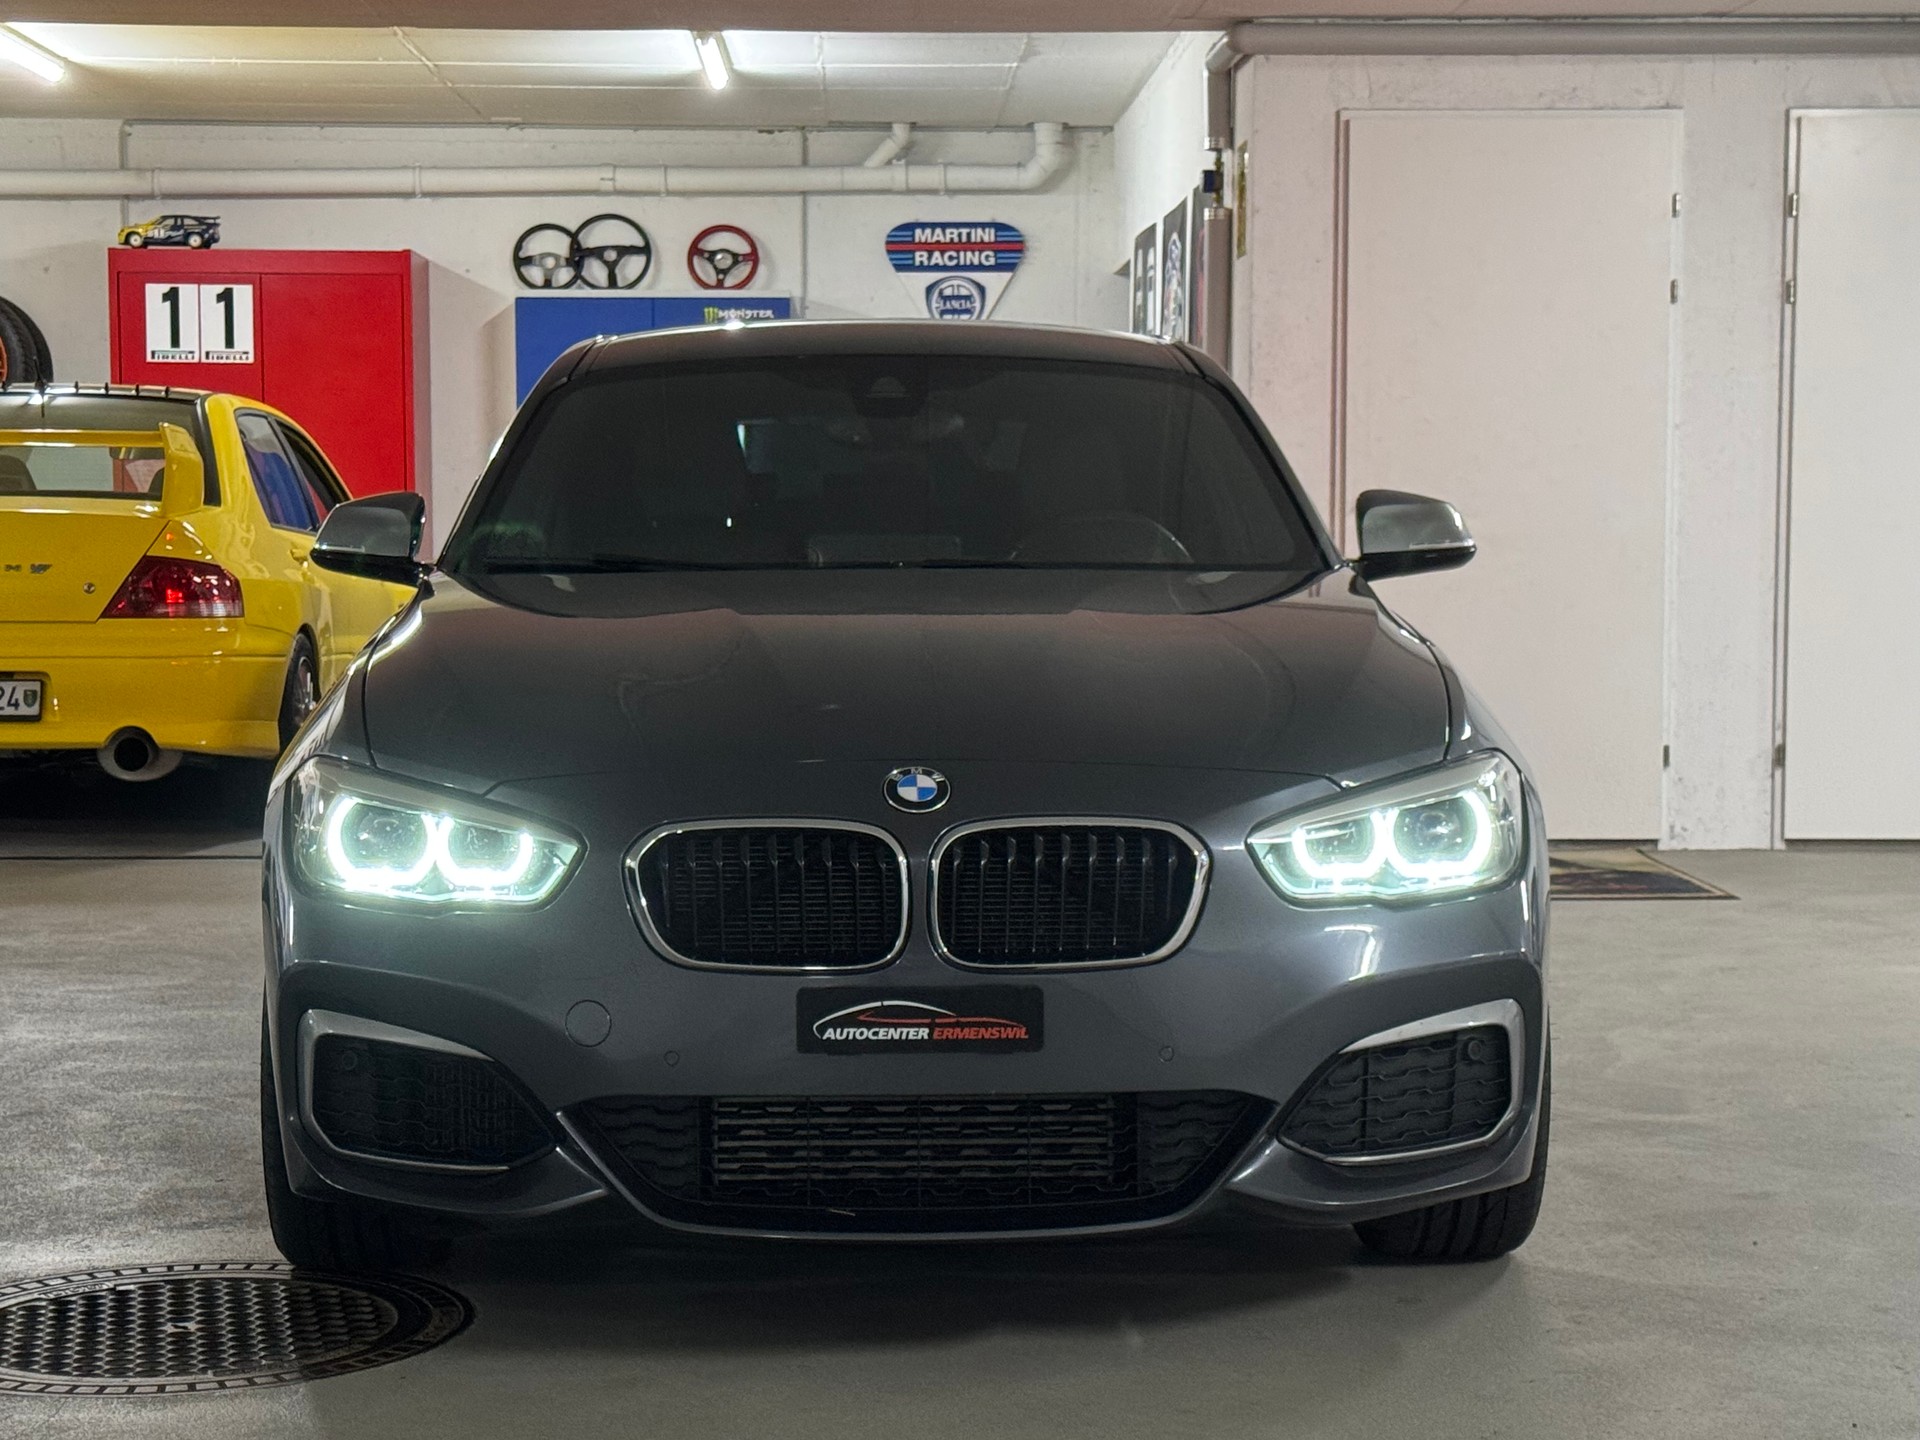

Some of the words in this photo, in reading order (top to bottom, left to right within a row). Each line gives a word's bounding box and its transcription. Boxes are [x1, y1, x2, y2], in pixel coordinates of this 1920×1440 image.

[914, 228, 996, 243] MARTINI
[914, 251, 996, 266] RACING
[718, 305, 774, 319] MONSTER
[888, 767, 947, 782] BMW
[822, 1027, 930, 1041] AUTOCENTER
[933, 1027, 1028, 1040] ERMENSWIL
